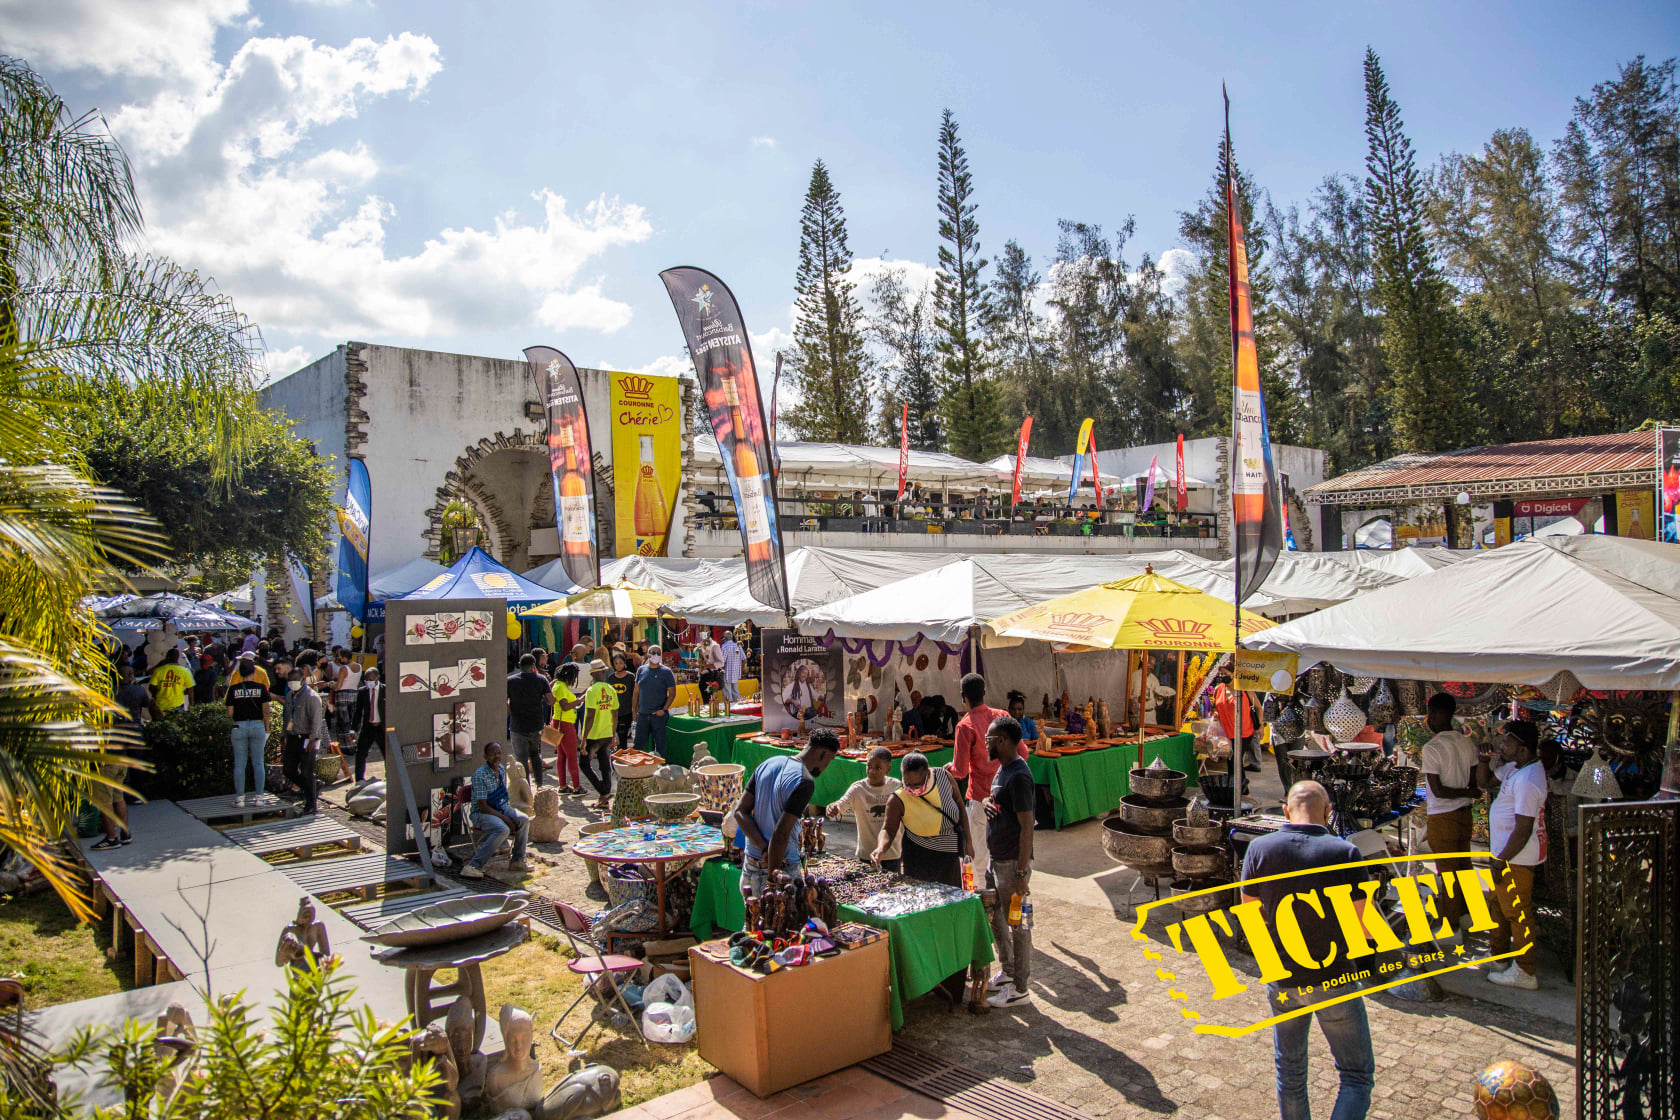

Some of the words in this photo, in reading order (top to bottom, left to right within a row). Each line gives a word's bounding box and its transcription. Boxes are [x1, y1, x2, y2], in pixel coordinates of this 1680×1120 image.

[618, 400, 654, 408] COURONNE
[619, 411, 659, 426] Chérie
[1534, 503, 1572, 515] Digicel
[507, 603, 528, 615] ote
[1144, 639, 1222, 648] COURONNE
[780, 645, 803, 653] Ronald
